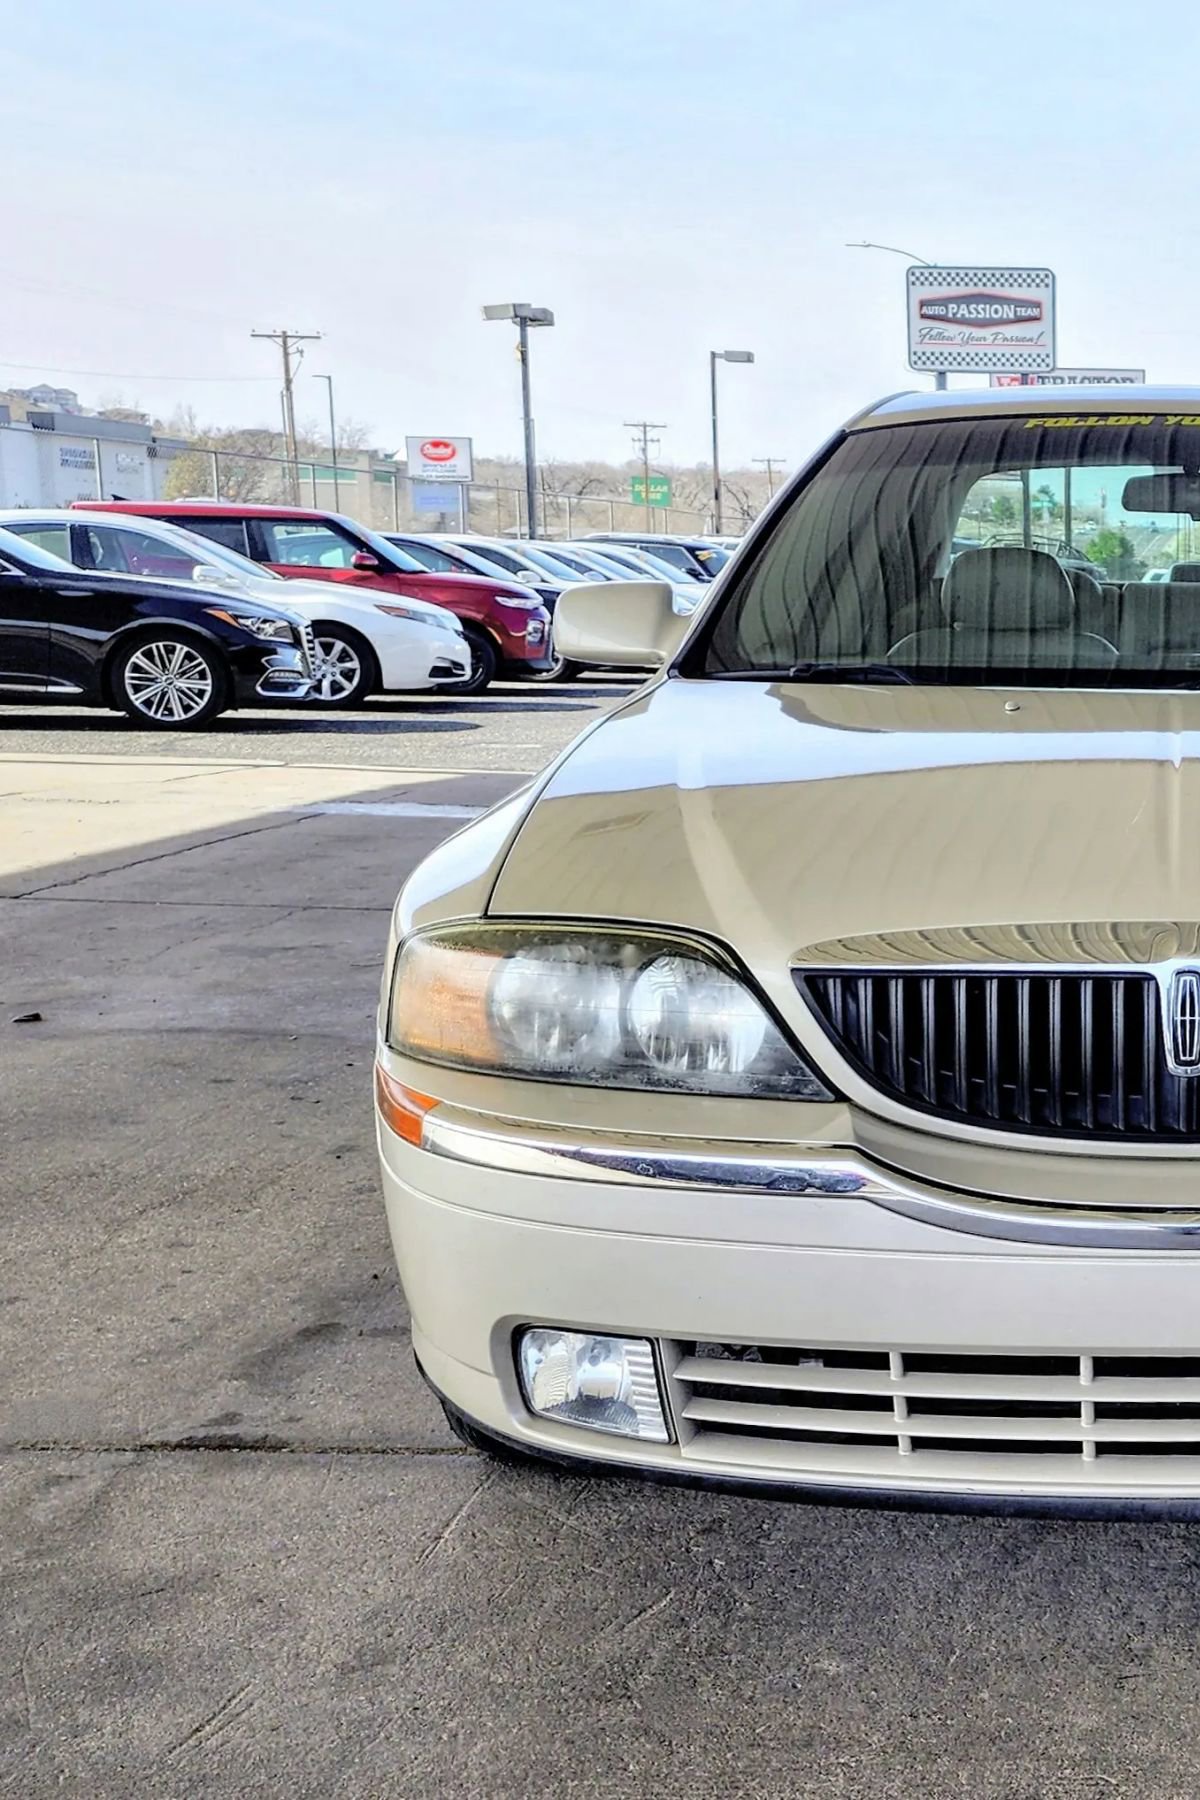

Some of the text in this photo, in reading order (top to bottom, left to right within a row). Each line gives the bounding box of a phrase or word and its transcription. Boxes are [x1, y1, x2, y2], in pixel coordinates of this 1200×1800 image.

[921, 303, 1040, 319] AUTO PASSION TEAM
[918, 327, 1046, 347] Follow Your Passion!
[1024, 416, 1155, 428] FOLLOW
